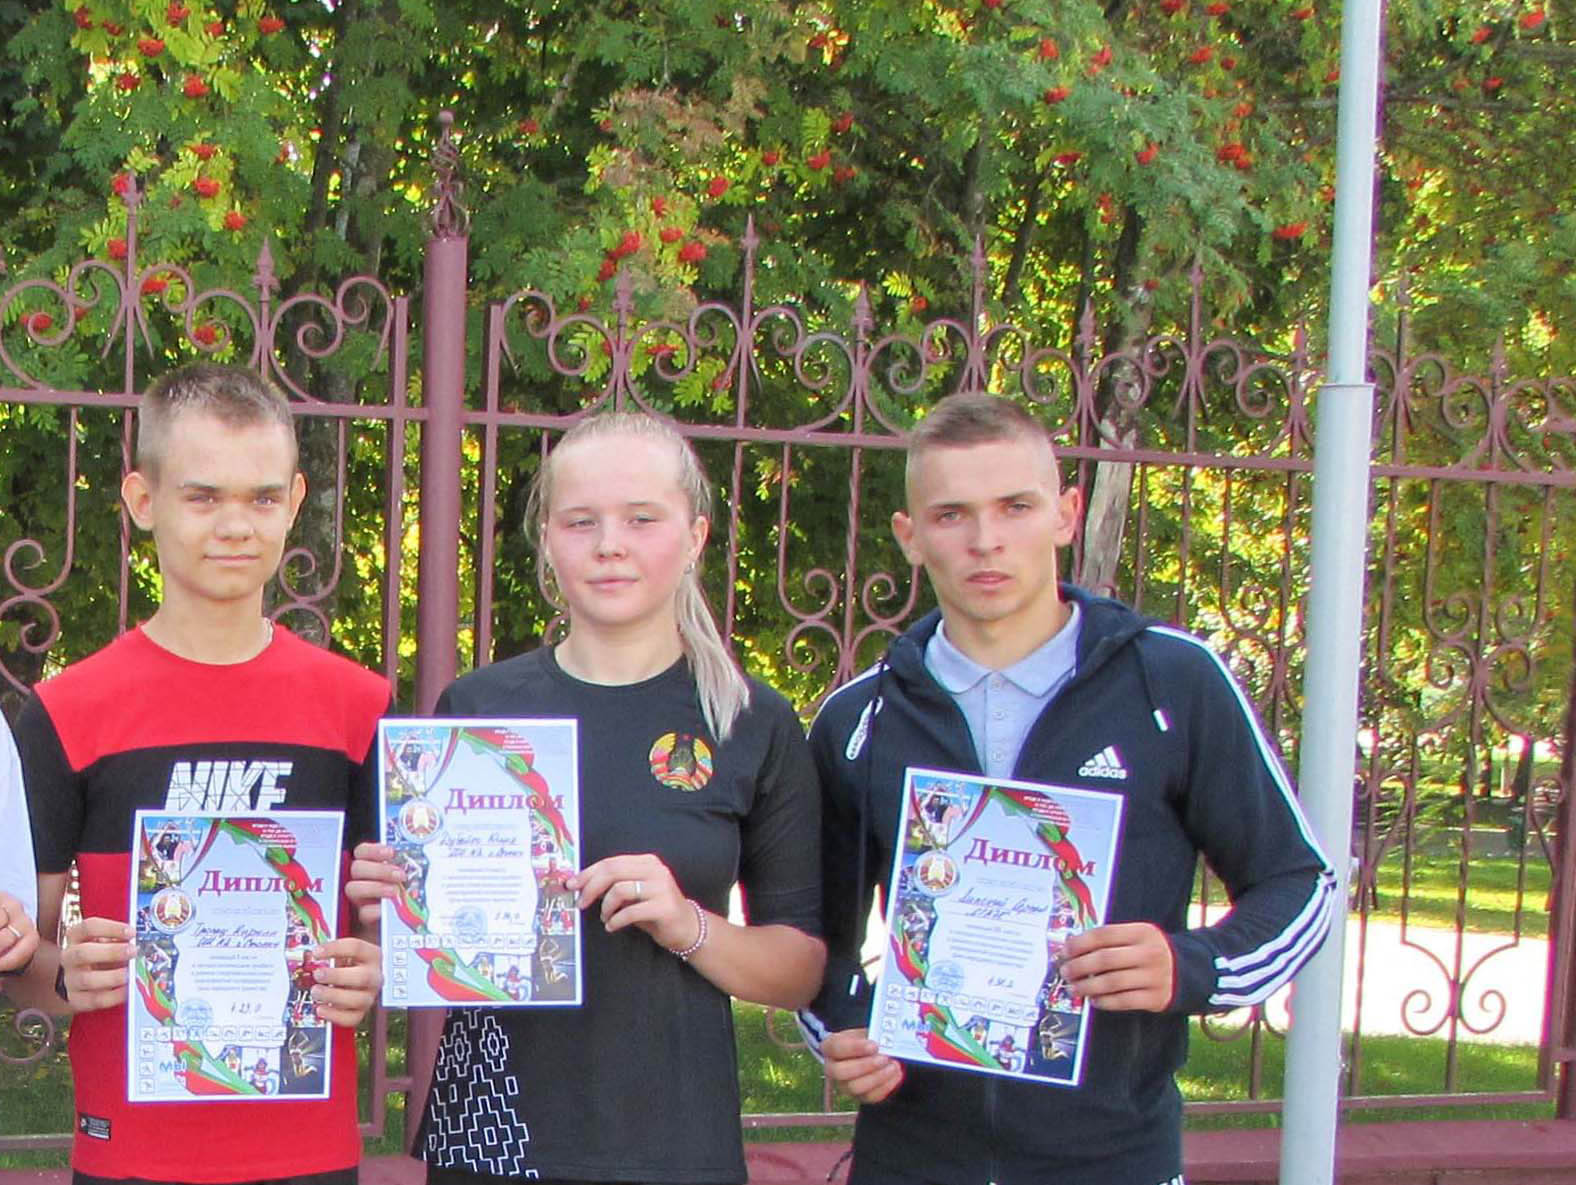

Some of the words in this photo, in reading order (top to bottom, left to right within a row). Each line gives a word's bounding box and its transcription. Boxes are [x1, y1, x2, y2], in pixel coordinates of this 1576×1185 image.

[165, 761, 293, 811] NIKE
[1078, 766, 1127, 780] adidas
[445, 788, 564, 814] Диплом
[964, 838, 1096, 876] Диплом
[198, 870, 323, 896] Диплом
